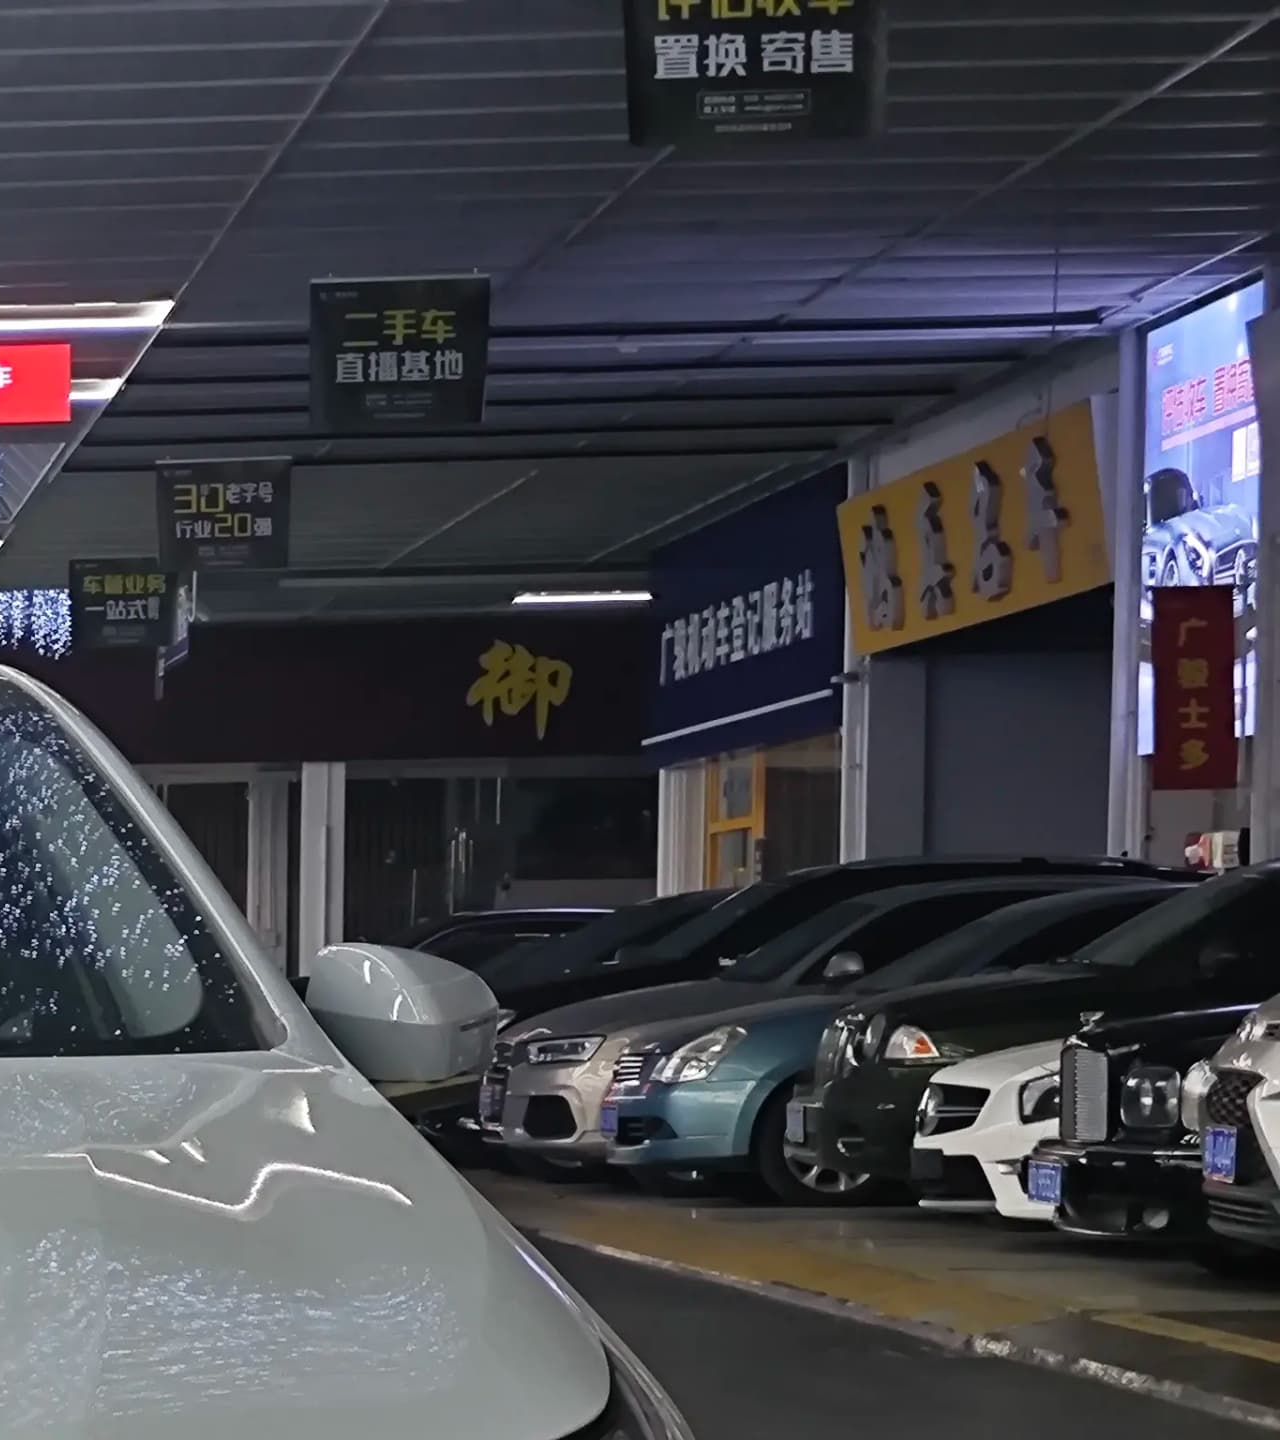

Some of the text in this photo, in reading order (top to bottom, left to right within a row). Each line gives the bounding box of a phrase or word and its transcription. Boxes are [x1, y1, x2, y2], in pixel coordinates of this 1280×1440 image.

[654, 30, 854, 79] 置换 寄售
[342, 309, 456, 346] 二手车
[336, 350, 463, 383] 直播基地
